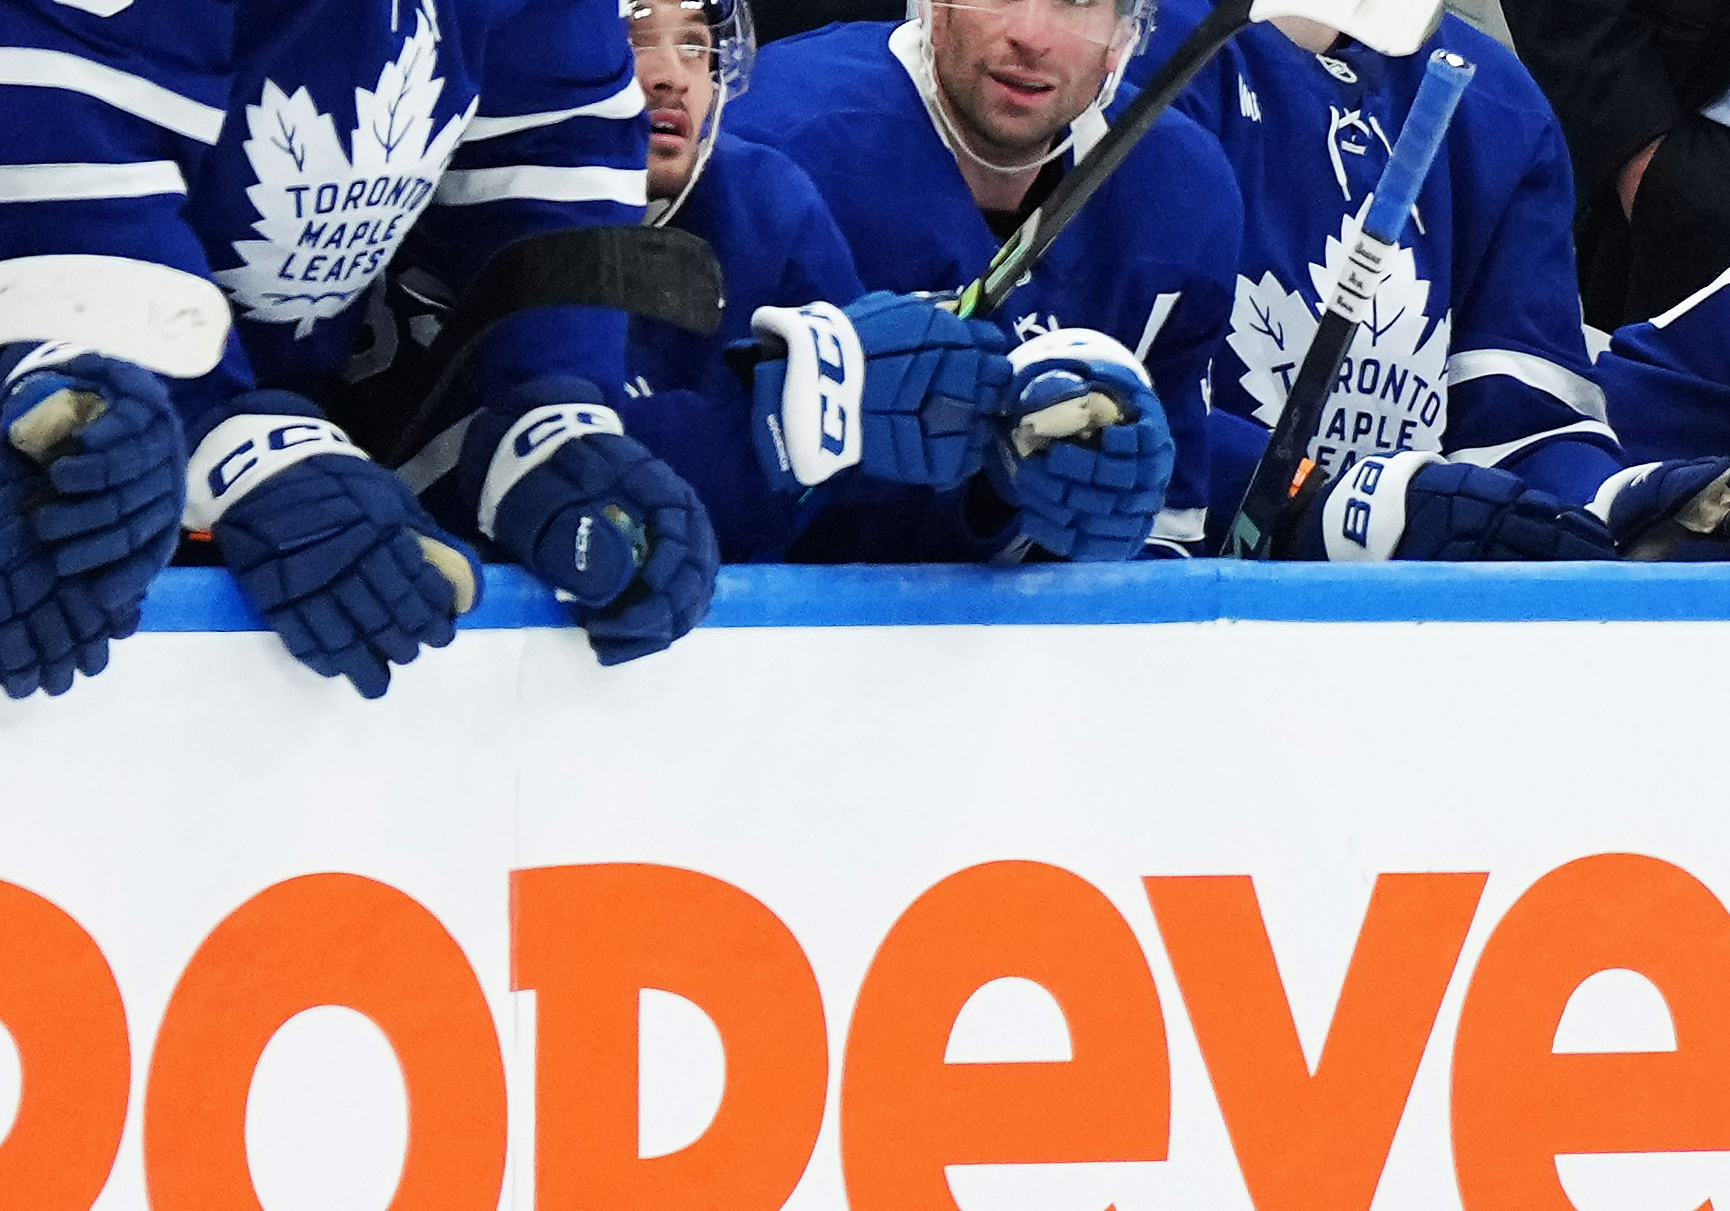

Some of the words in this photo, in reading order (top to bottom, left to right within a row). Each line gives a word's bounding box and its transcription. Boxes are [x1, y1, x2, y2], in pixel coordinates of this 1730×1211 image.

[284, 175, 434, 219] TORONTO
[297, 213, 404, 250] MAPLE
[277, 247, 387, 283] LEAFS
[800, 310, 847, 458] CC
[1270, 356, 1442, 429] TRONTO
[1325, 407, 1419, 452] APLE
[208, 424, 344, 500] CC
